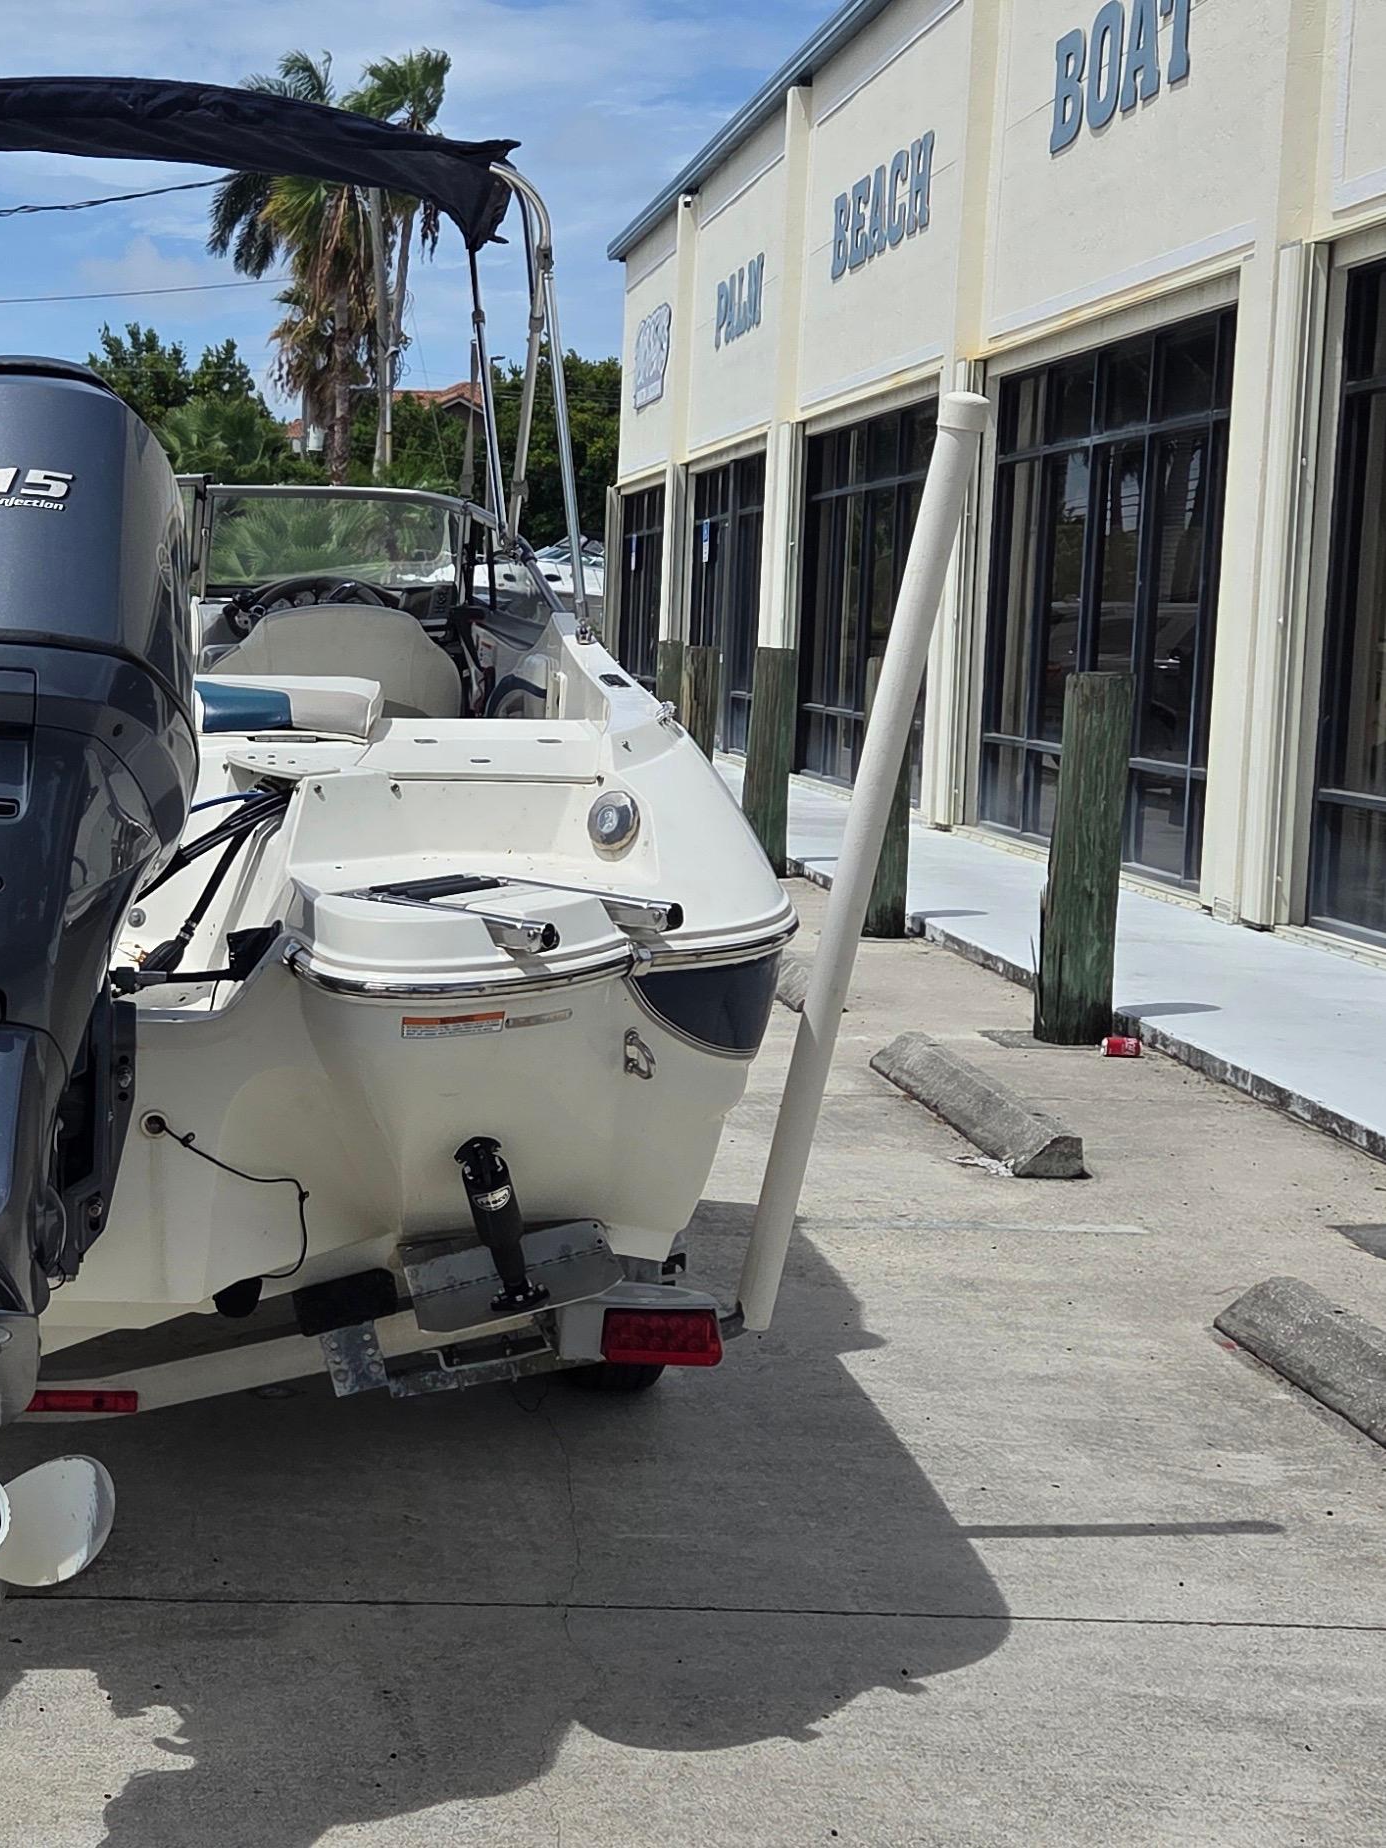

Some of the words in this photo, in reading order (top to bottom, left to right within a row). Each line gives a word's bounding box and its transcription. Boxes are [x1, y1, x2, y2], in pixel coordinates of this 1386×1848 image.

[715, 252, 764, 351] PALM
[831, 130, 935, 280] BEACH
[1049, 0, 1191, 155] BOAT
